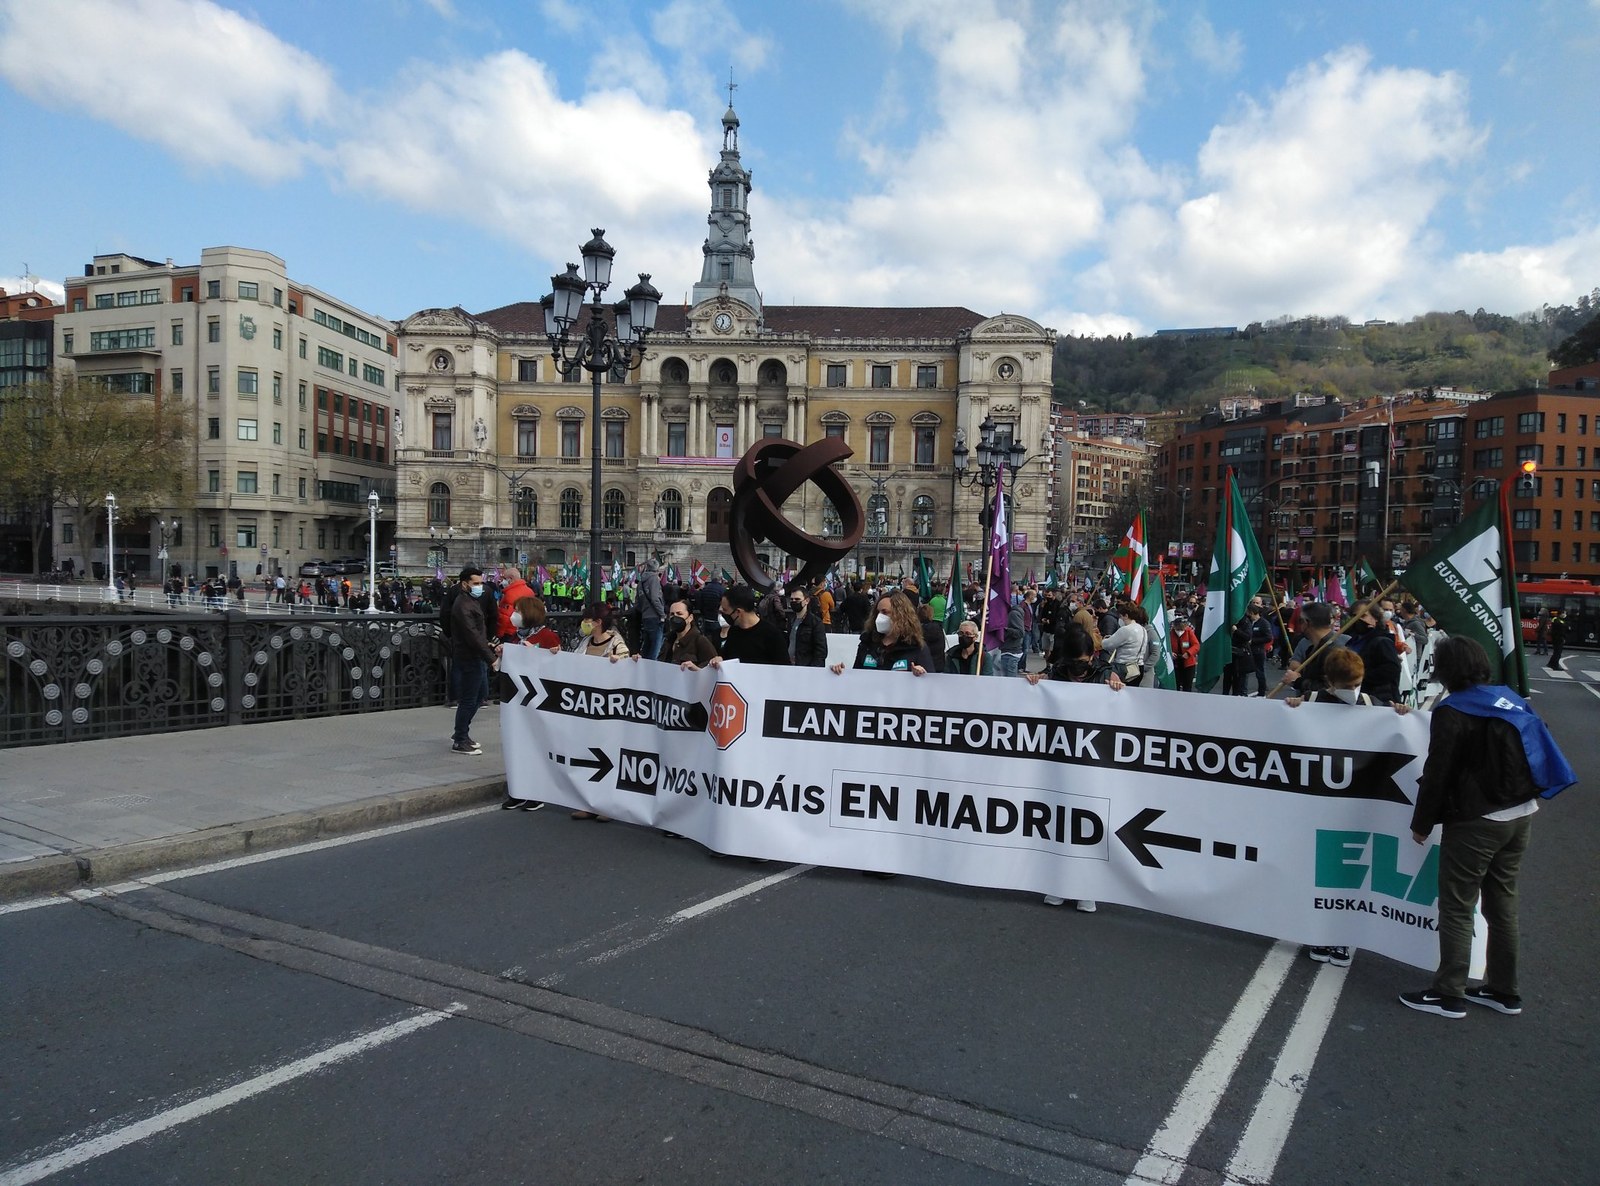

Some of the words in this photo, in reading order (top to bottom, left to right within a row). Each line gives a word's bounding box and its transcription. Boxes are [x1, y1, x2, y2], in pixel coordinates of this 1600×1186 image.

[1433, 561, 1473, 604] EUSKAL
[560, 687, 691, 728] SARRASKIARI
[782, 706, 846, 736] LAN
[855, 711, 1101, 760] ERREFORMAK
[1113, 732, 1353, 790] DEROGATU
[620, 754, 658, 785] NO
[662, 765, 698, 797] NOS
[840, 782, 899, 821] EN
[915, 789, 1105, 846] MADRID
[1314, 898, 1377, 914] EUSKAL
